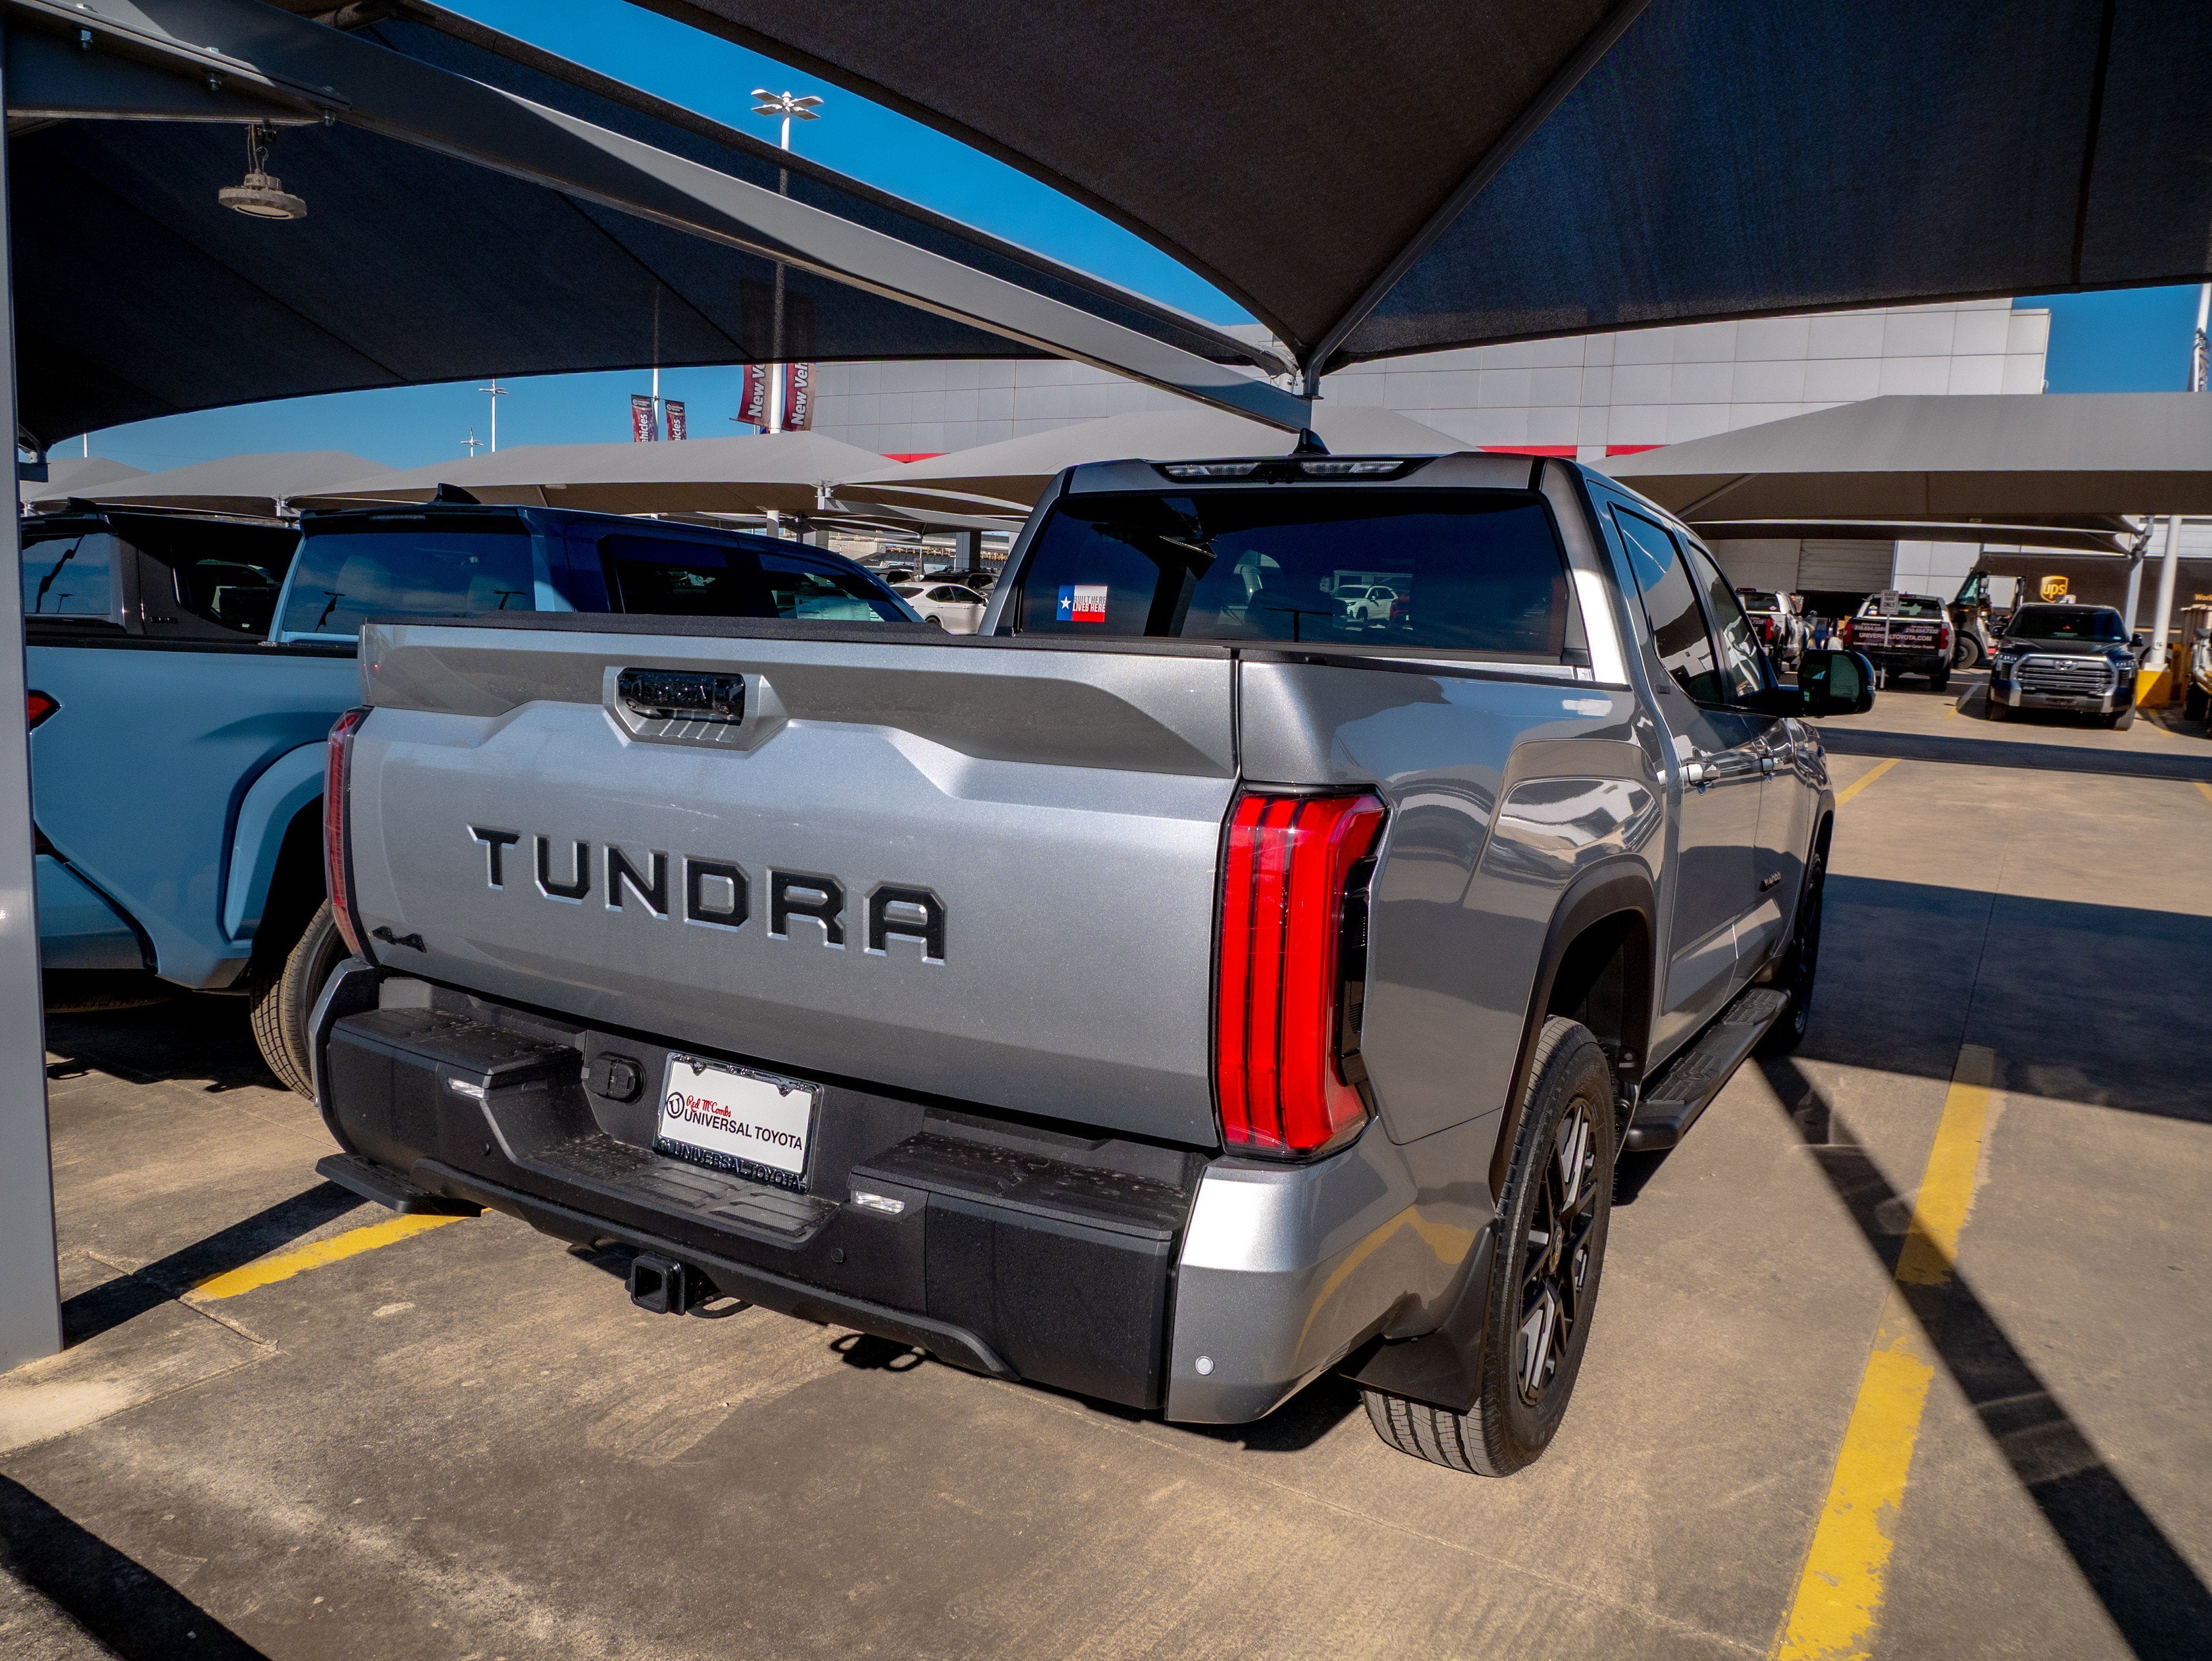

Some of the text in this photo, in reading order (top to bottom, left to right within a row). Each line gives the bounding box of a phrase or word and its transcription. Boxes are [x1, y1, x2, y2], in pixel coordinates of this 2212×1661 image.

[748, 381, 765, 418] New
[791, 391, 807, 425] New
[1091, 596, 1106, 604] HERE
[2043, 584, 2065, 599] ups
[1073, 603, 1105, 612] LIVES HERE
[1859, 633, 1932, 641] UNIVERSLTOYOTA.COM
[468, 824, 946, 966] TUNDRA
[686, 1095, 731, 1118] Red McCombs
[684, 1108, 802, 1151] UNIVERSAL TOYOTA
[675, 1141, 801, 1191] UNIVERSAL TOYOTA
